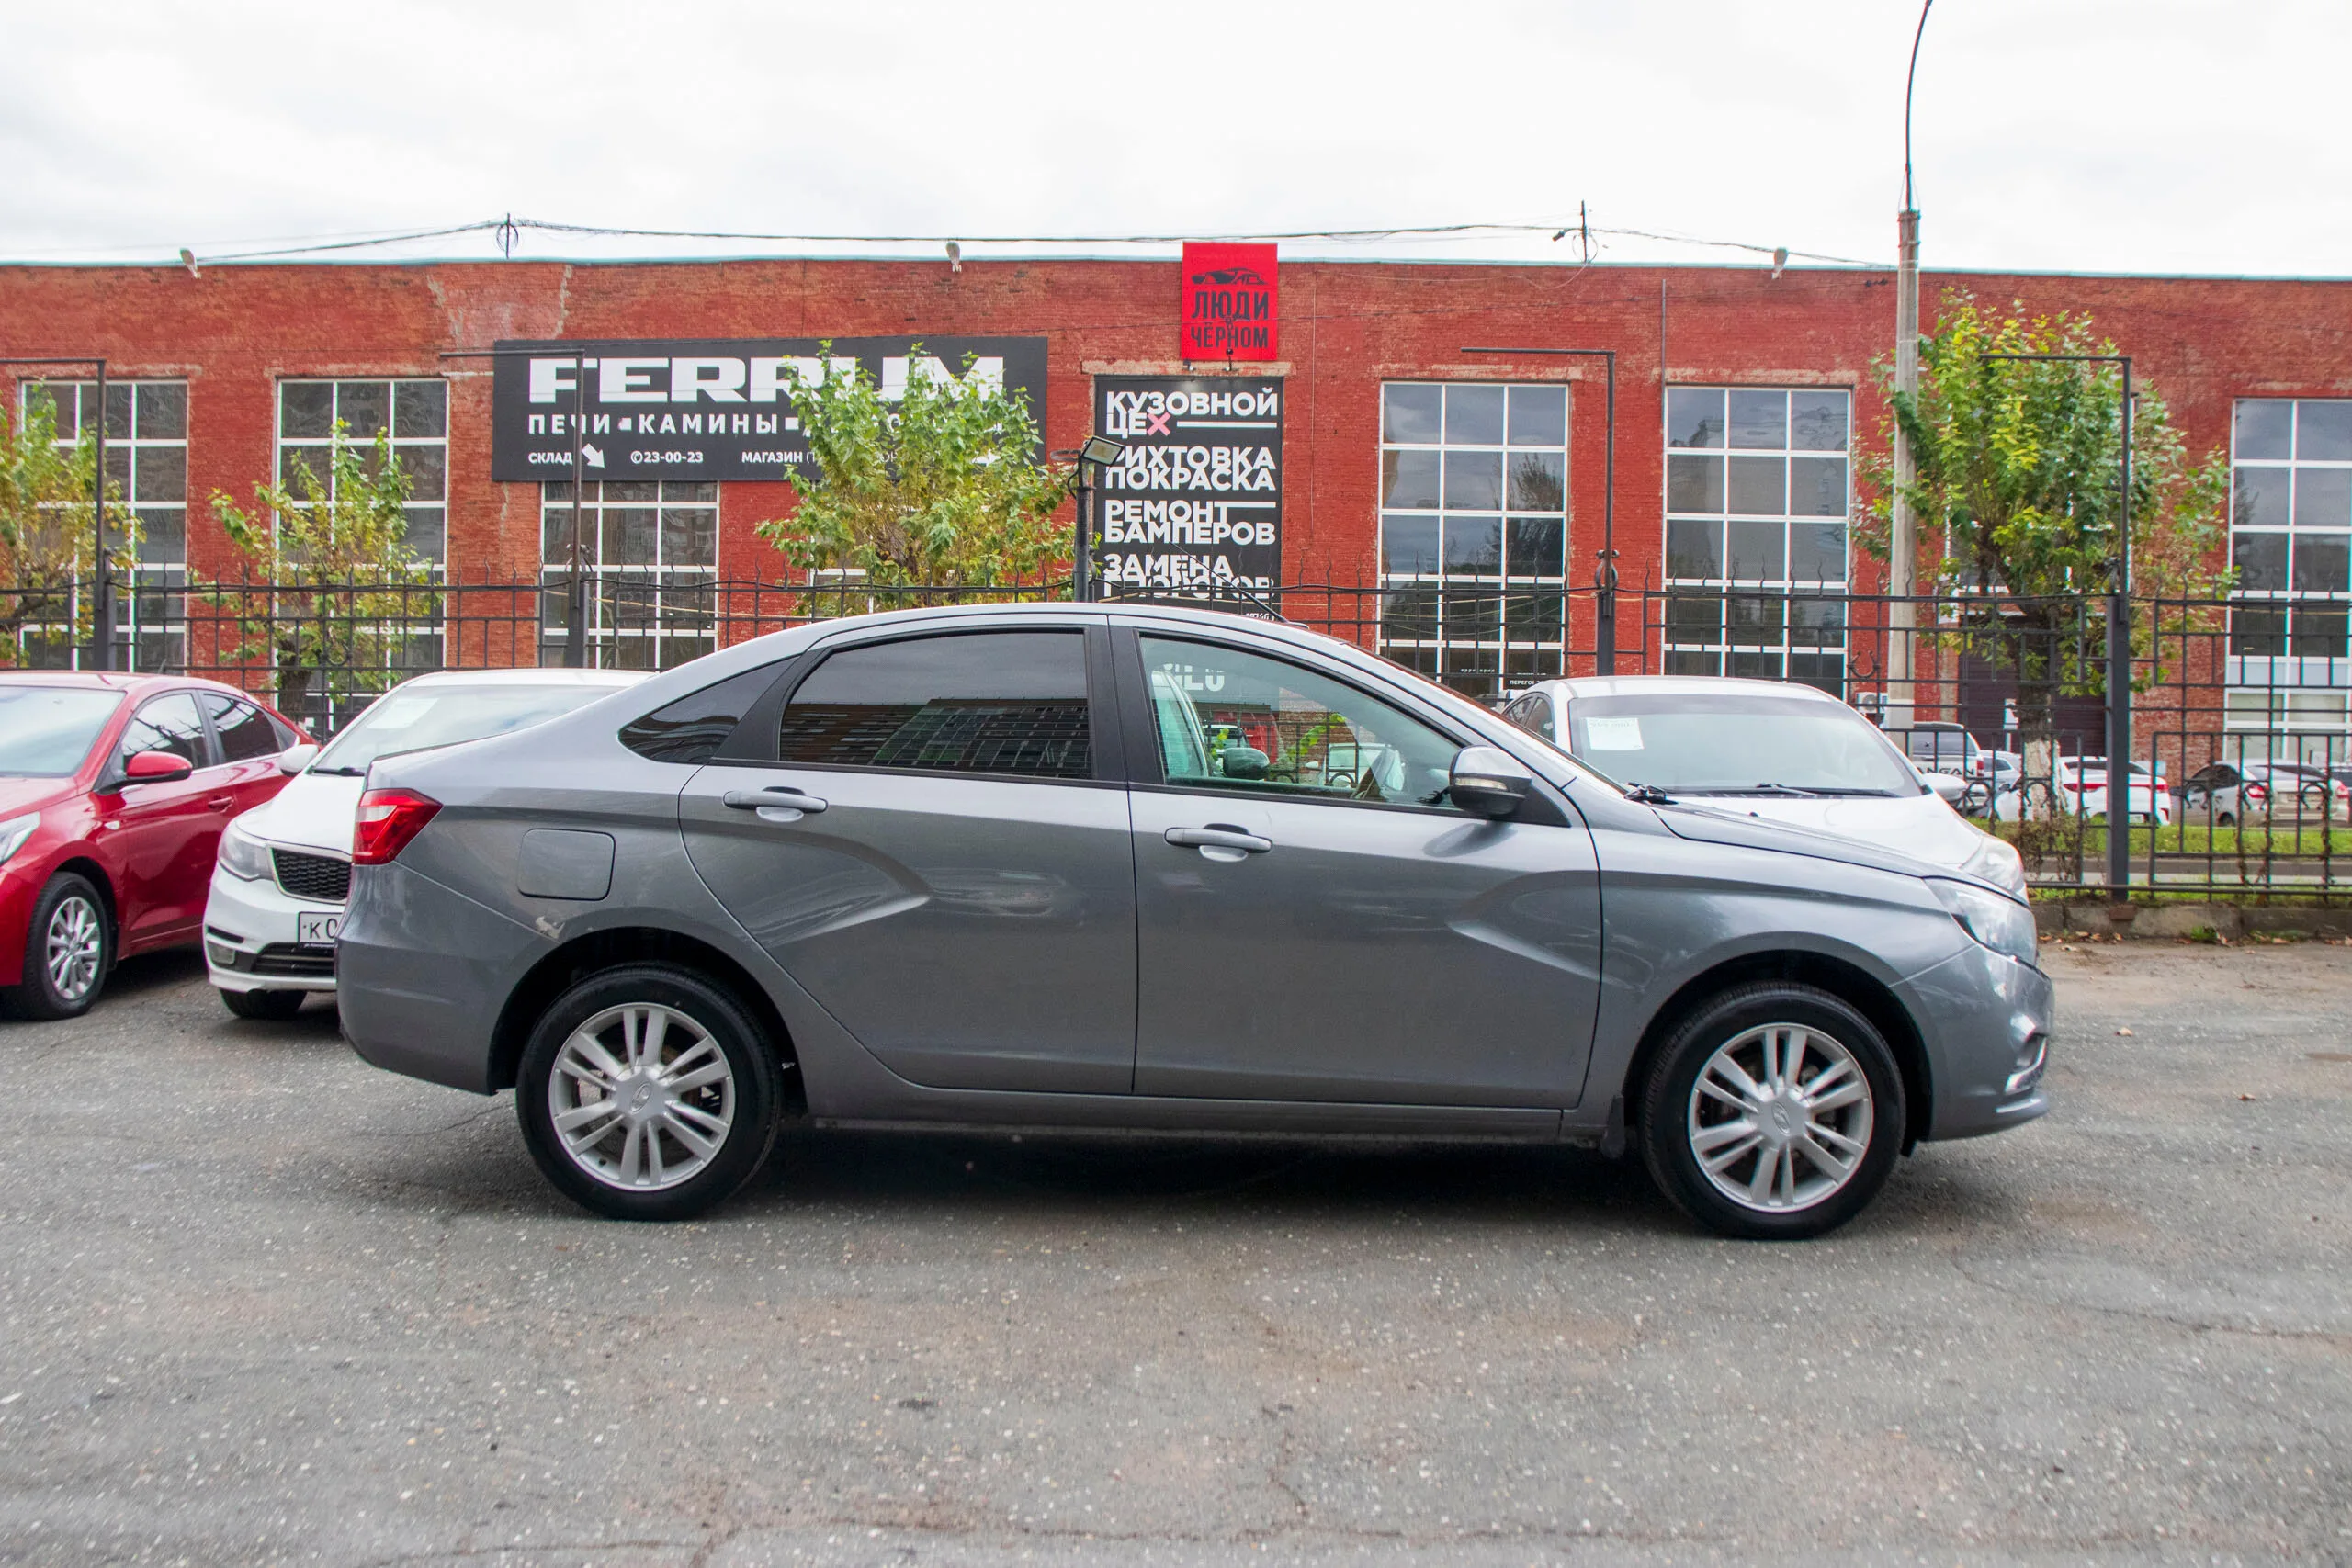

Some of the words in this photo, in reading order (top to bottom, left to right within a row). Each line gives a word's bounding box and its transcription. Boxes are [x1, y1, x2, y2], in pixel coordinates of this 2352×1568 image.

[1191, 291, 1269, 321] ЛЮДИ
[1191, 322, 1269, 349] ЧЁРНОМ
[529, 357, 1004, 403] FERRUM
[1105, 386, 1278, 416] КУЗОВНОЙ
[528, 413, 610, 434] ПЕЧИ
[639, 413, 778, 434] КАМИНЫ
[1105, 412, 1171, 439] ЦЕХ
[527, 451, 573, 465] СКЛАД
[741, 451, 803, 464] МАГАЗИН
[1115, 445, 1276, 470] ИХТОВКА
[1105, 466, 1276, 491] ПОКРАСКА
[1105, 499, 1276, 524] РЕМОНТ
[1104, 520, 1276, 545] БАМПЕРОВ
[1103, 553, 1234, 578] ЗАМЕНА
